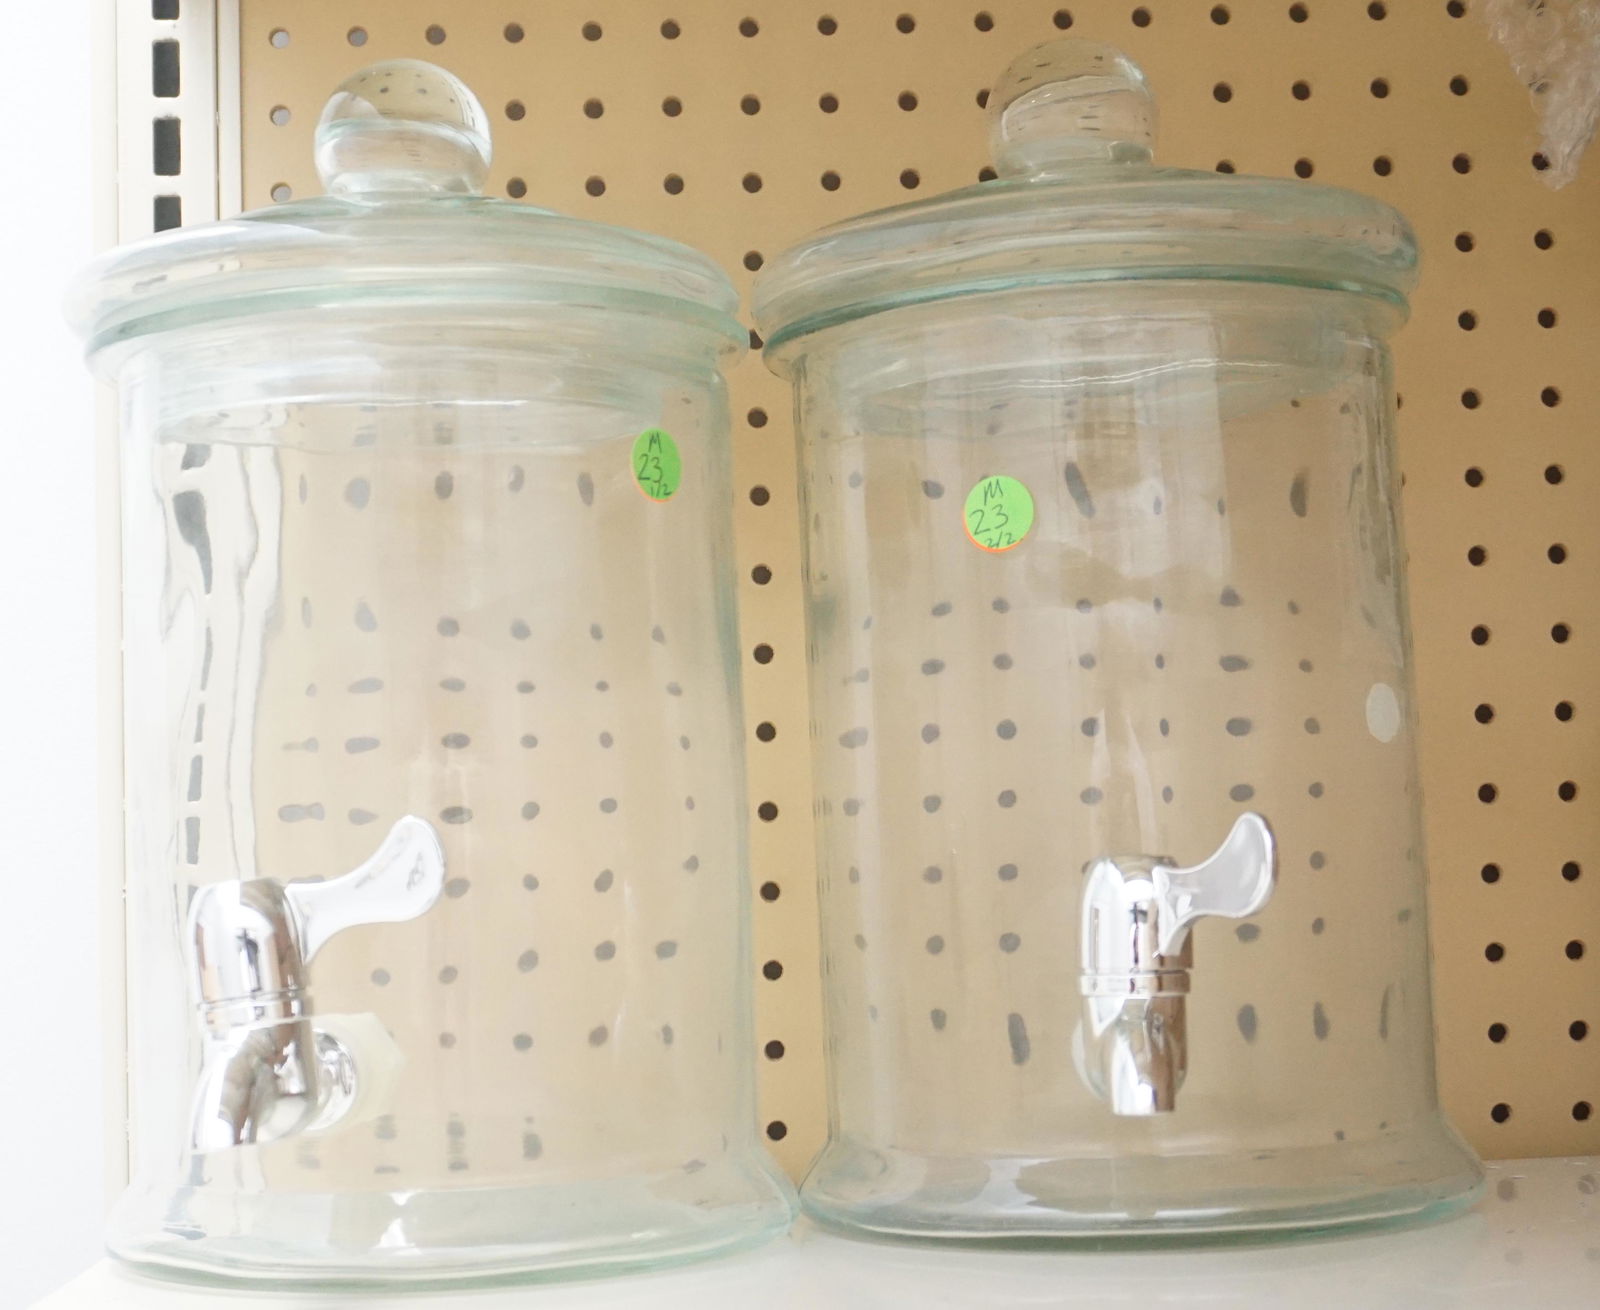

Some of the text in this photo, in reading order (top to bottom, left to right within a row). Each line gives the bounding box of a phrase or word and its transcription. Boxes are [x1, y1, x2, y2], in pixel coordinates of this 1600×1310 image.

[648, 431, 662, 453] M
[637, 453, 664, 483] 23
[650, 482, 673, 498] 1/2
[983, 478, 1004, 506] M
[969, 504, 1009, 535] 23
[984, 529, 1017, 548] 2/2
